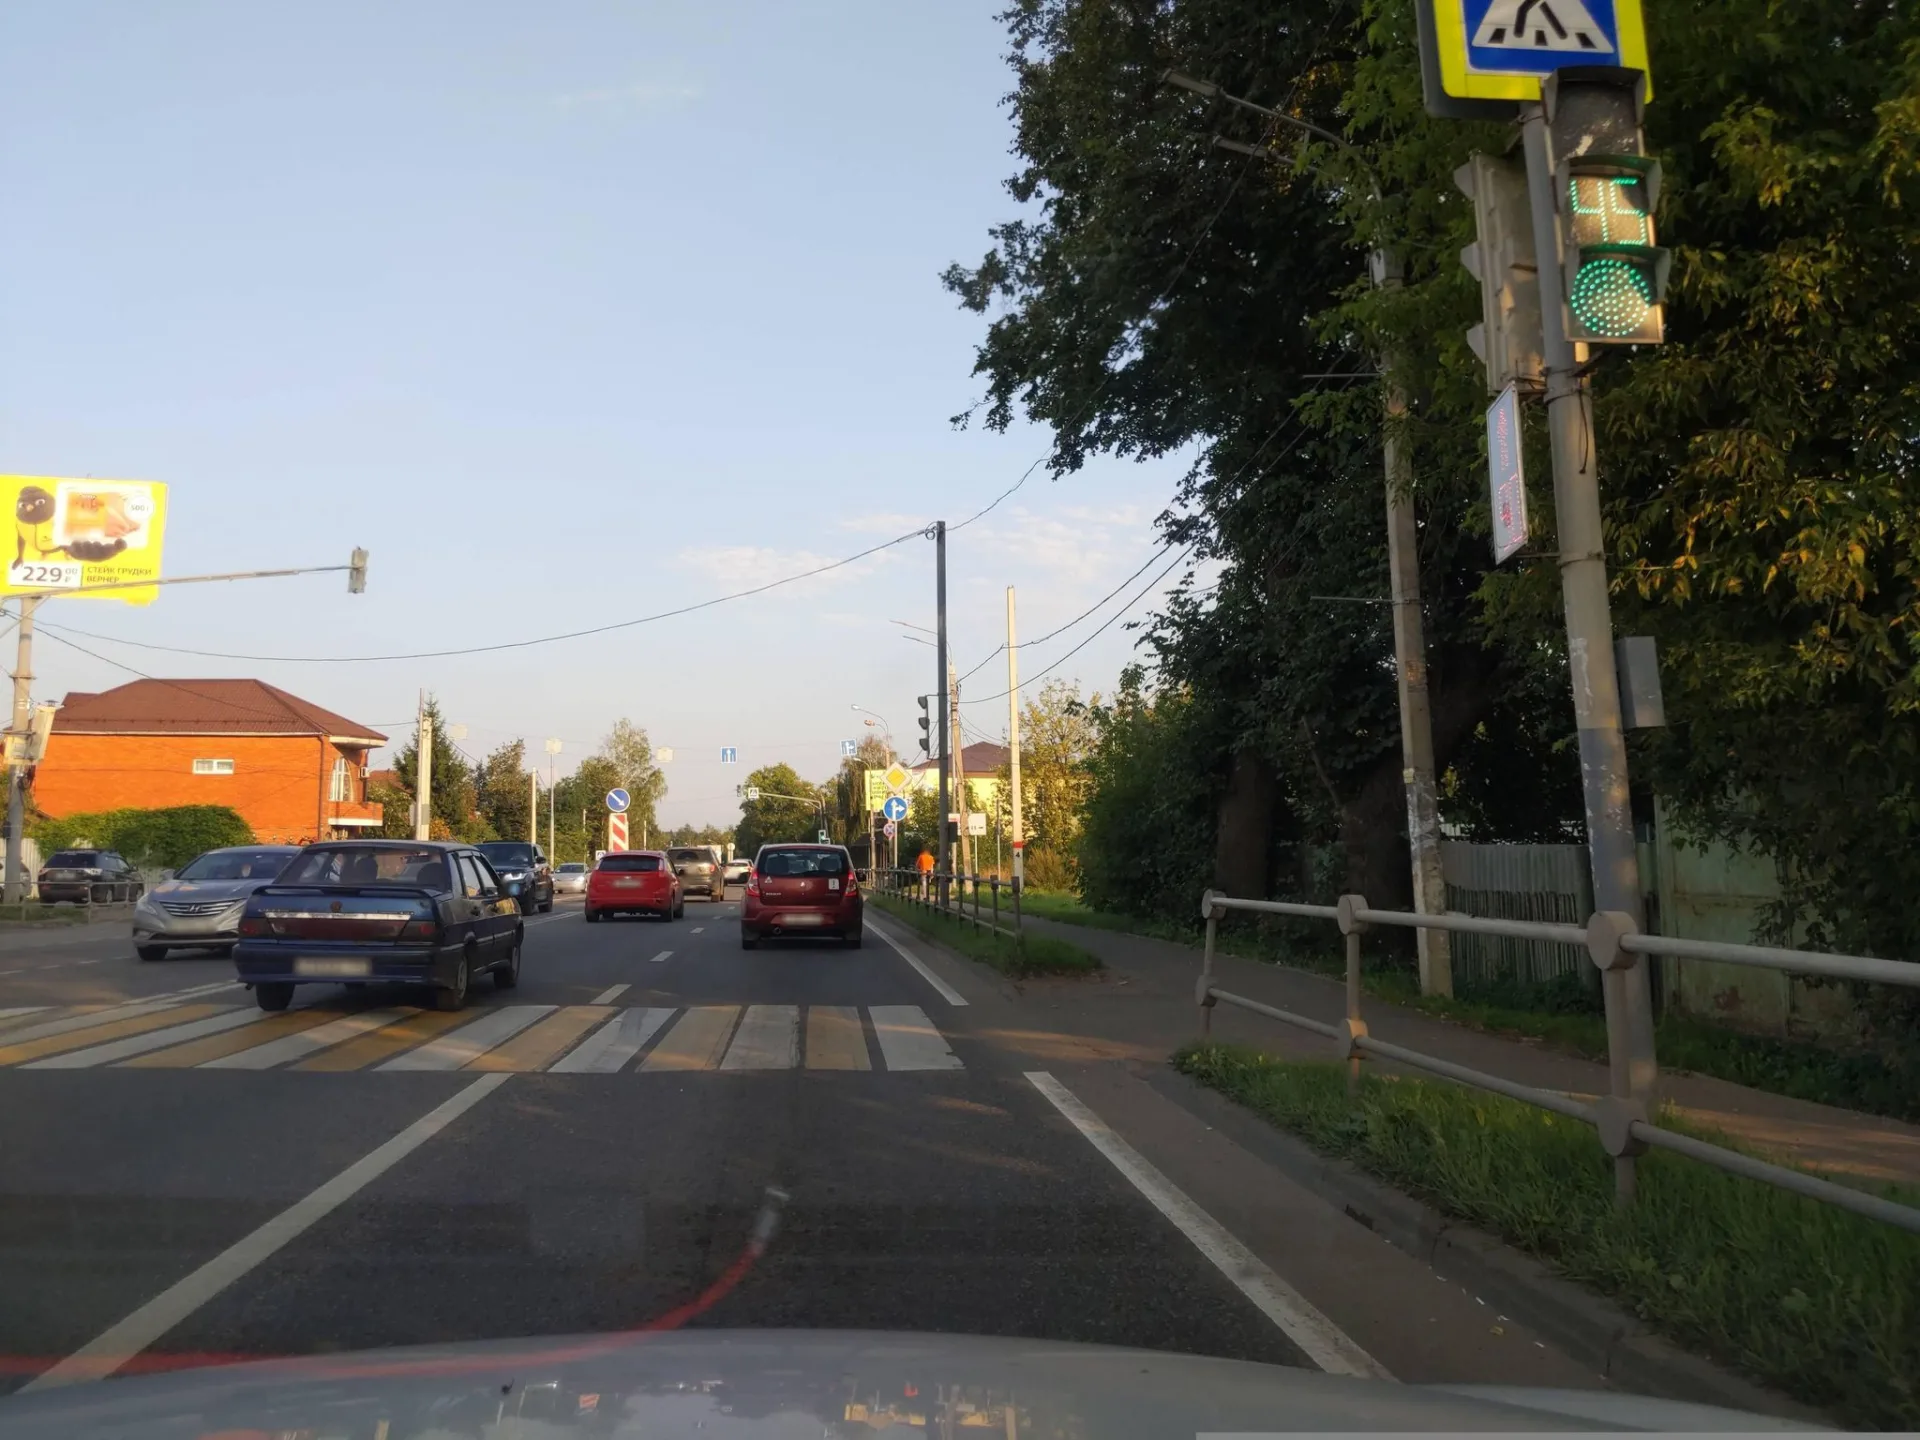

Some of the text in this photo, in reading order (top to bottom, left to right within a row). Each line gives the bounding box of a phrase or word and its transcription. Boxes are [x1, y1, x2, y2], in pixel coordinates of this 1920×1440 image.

[1570, 177, 1648, 246] 45
[22, 566, 62, 583] 229
[87, 565, 152, 576] СТЕЙК ГРУДКИ
